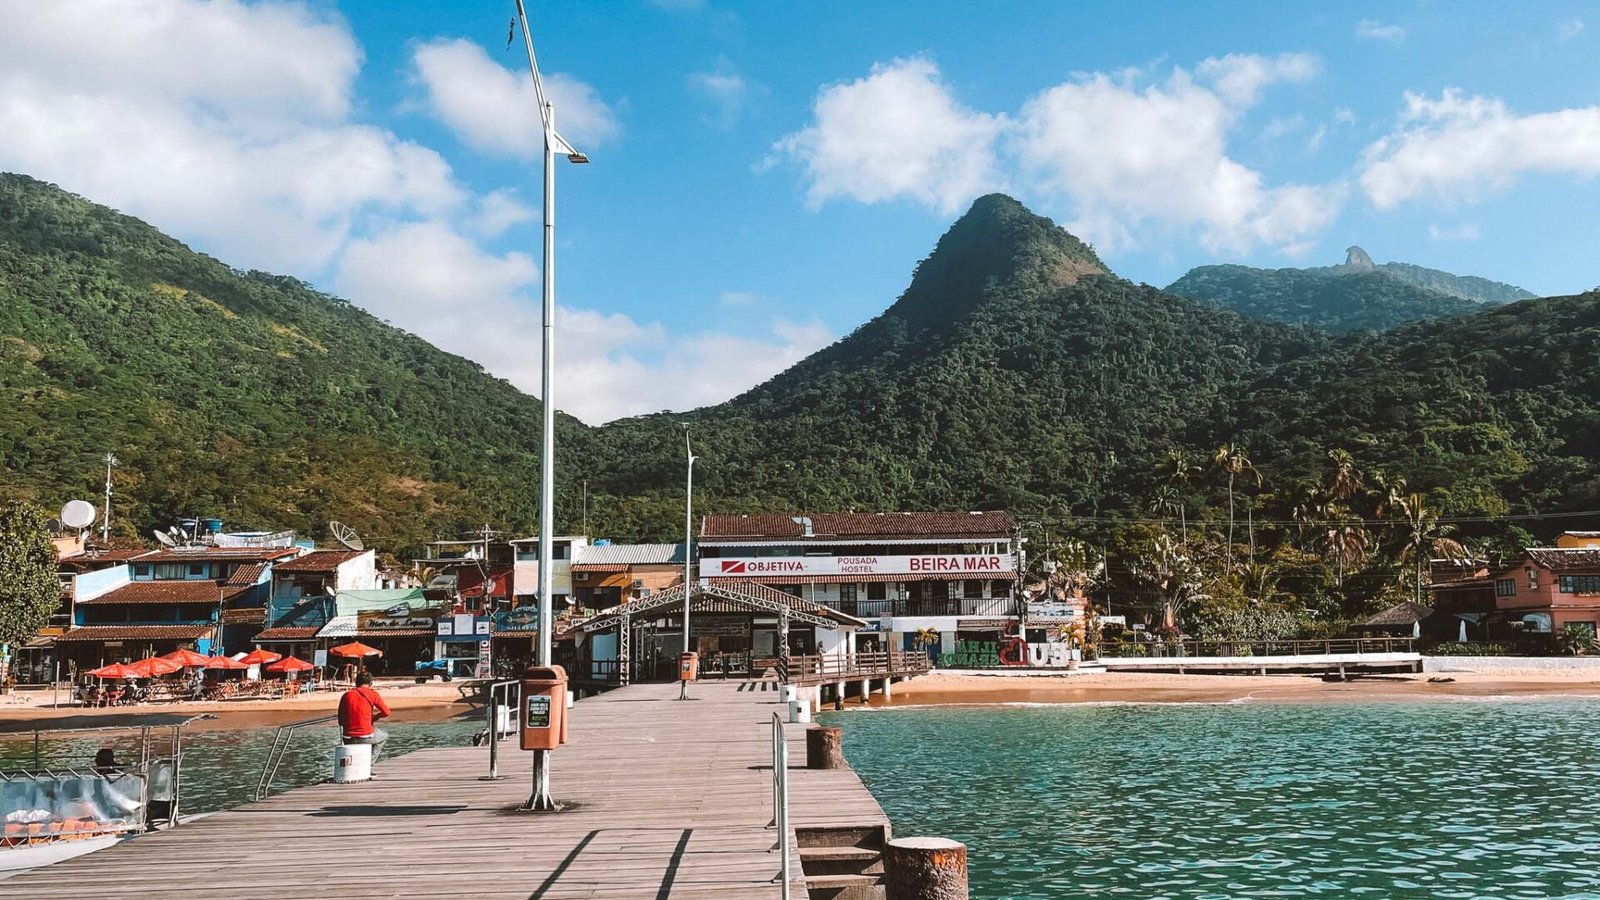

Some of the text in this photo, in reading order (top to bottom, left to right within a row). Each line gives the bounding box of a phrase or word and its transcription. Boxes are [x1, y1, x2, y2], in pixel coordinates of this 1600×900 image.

[838, 557, 878, 565] POUSADA
[910, 556, 1001, 571] BEIRA MAR
[748, 562, 804, 572] OBJETIVA
[841, 565, 874, 573] HOSTEL
